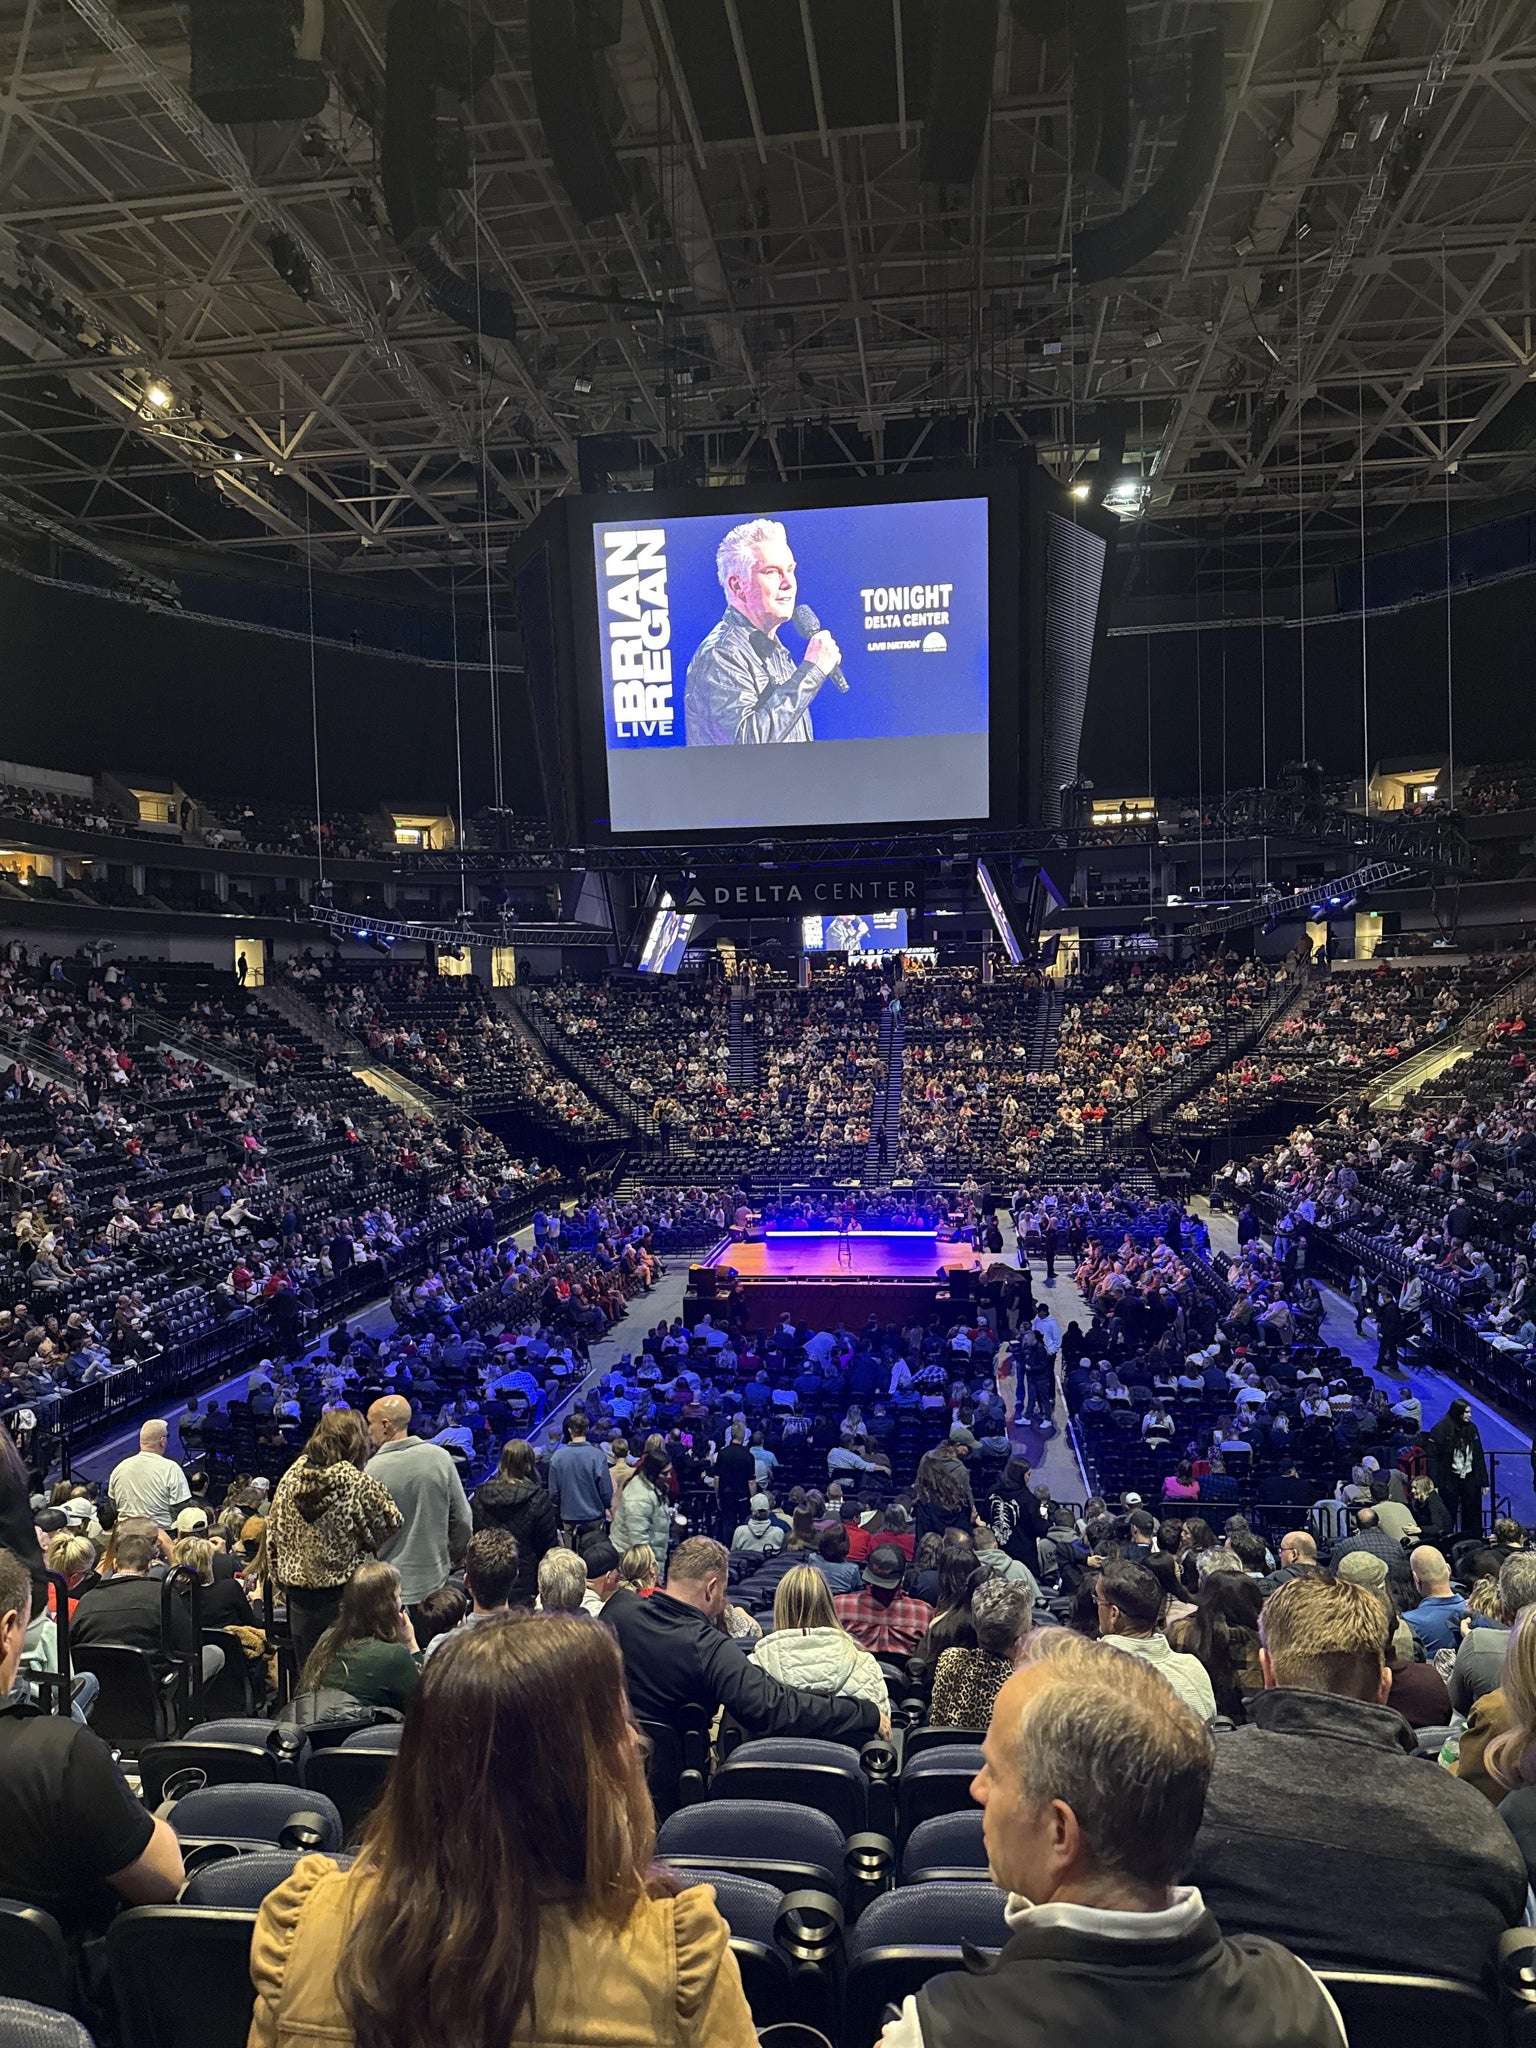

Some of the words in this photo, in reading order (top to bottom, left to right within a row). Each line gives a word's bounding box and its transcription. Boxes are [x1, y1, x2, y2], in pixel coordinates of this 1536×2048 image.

[860, 583, 953, 613] TONIGHT
[604, 531, 647, 722] BRIAN
[636, 529, 674, 721] REGAN
[864, 614, 901, 630] DELTA
[902, 611, 949, 627] CENTER
[616, 720, 673, 738] LIVE
[714, 885, 803, 904] DELTA
[814, 881, 916, 901] CENTER
